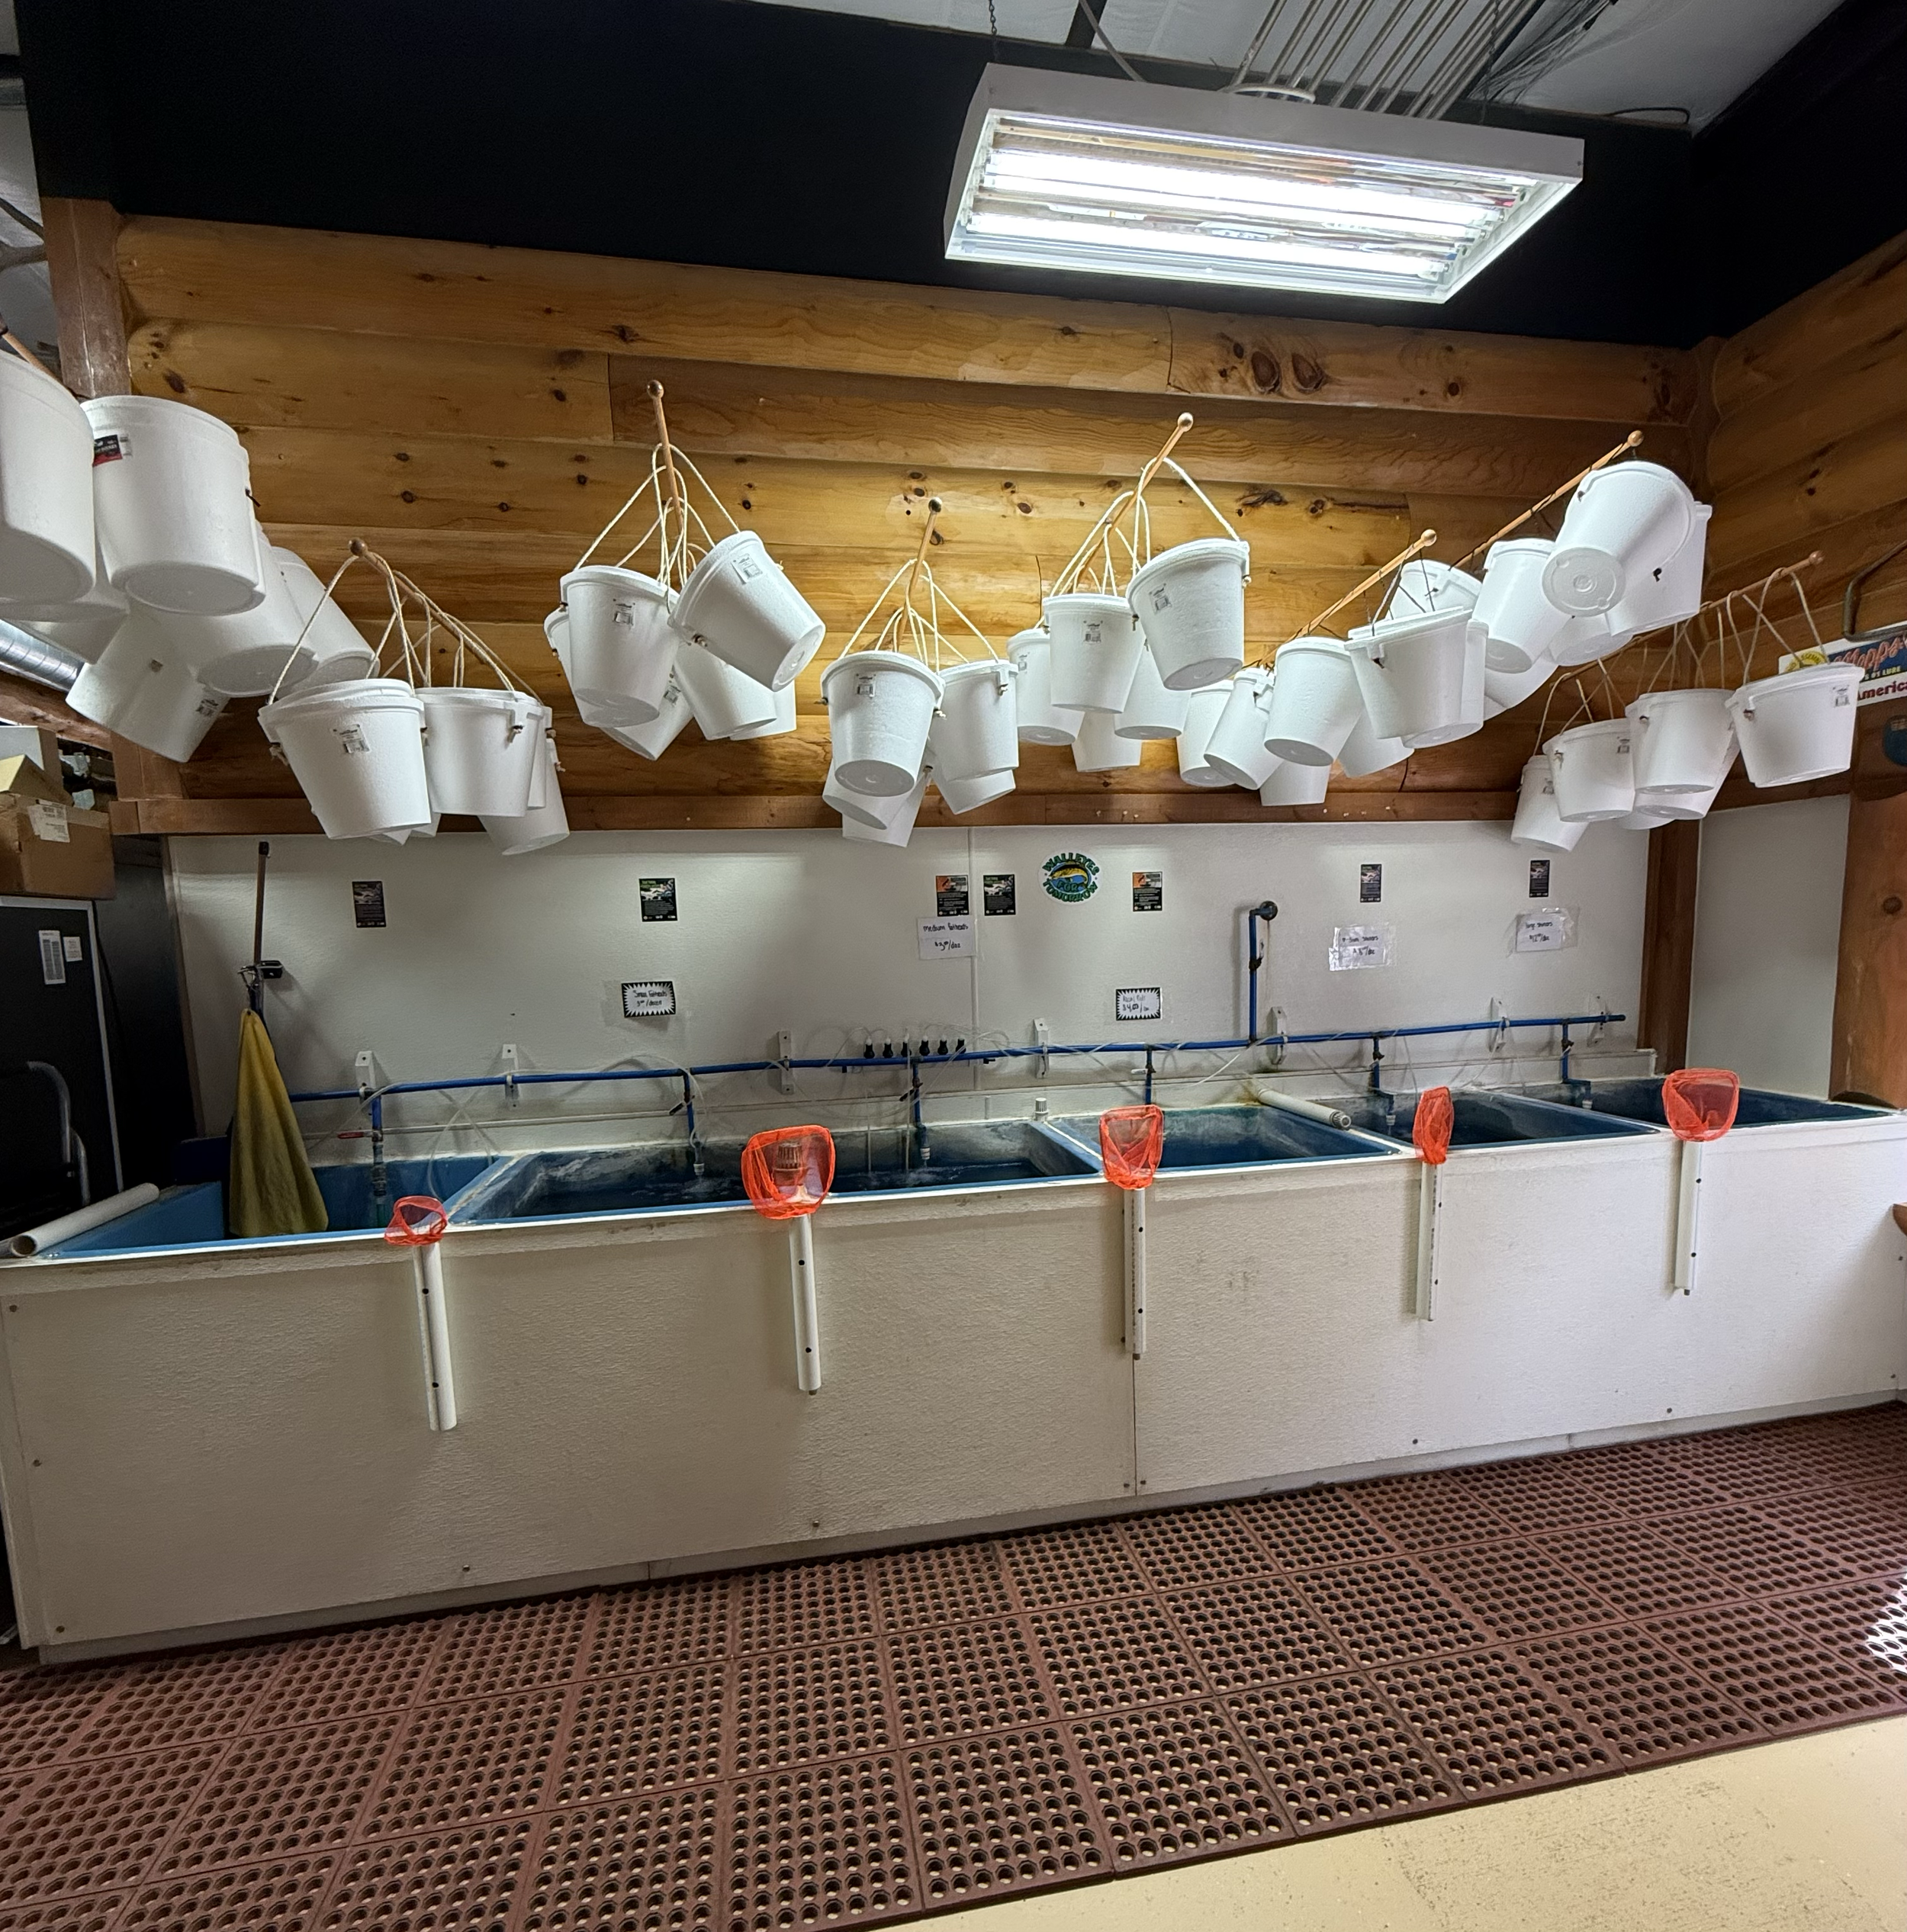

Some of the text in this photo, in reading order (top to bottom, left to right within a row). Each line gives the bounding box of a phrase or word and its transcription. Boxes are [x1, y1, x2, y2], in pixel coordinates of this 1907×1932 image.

[1882, 665, 1901, 676] LURE
[1043, 878, 1098, 902] TOMORROW
[1057, 880, 1079, 892] FOR
